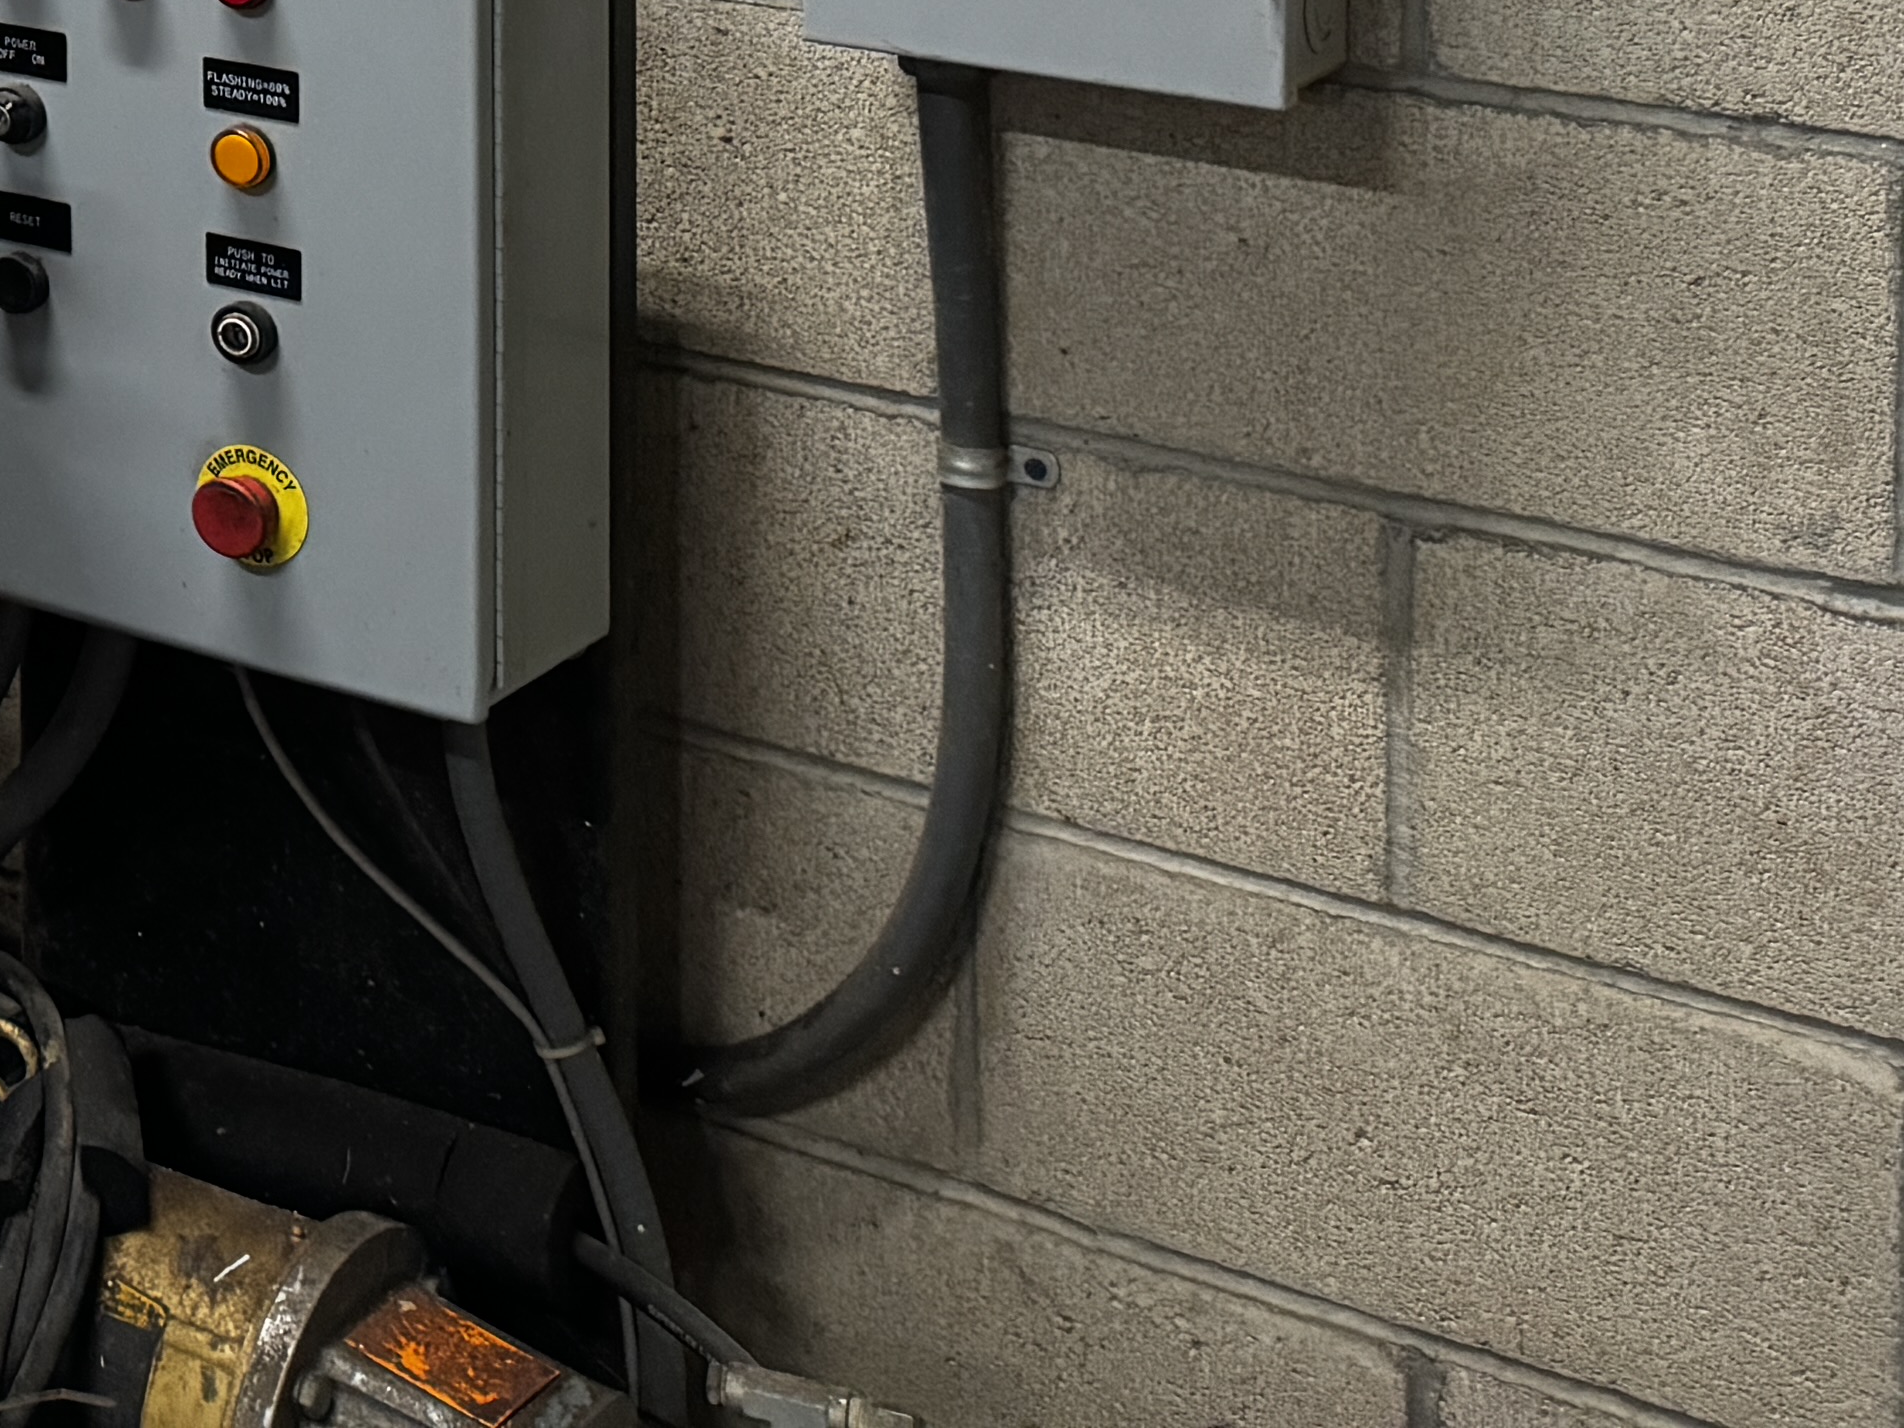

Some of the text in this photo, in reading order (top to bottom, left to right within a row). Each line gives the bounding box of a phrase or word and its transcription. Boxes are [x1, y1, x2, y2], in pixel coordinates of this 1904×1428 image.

[4, 35, 36, 51] POWER
[32, 54, 45, 66] ON
[9, 211, 41, 227] RESET
[228, 245, 275, 266] PUSH TO
[214, 256, 290, 279] INITIATE POWER
[214, 266, 289, 289] READY WHEN LIT
[206, 447, 297, 492] EMERGENCY
